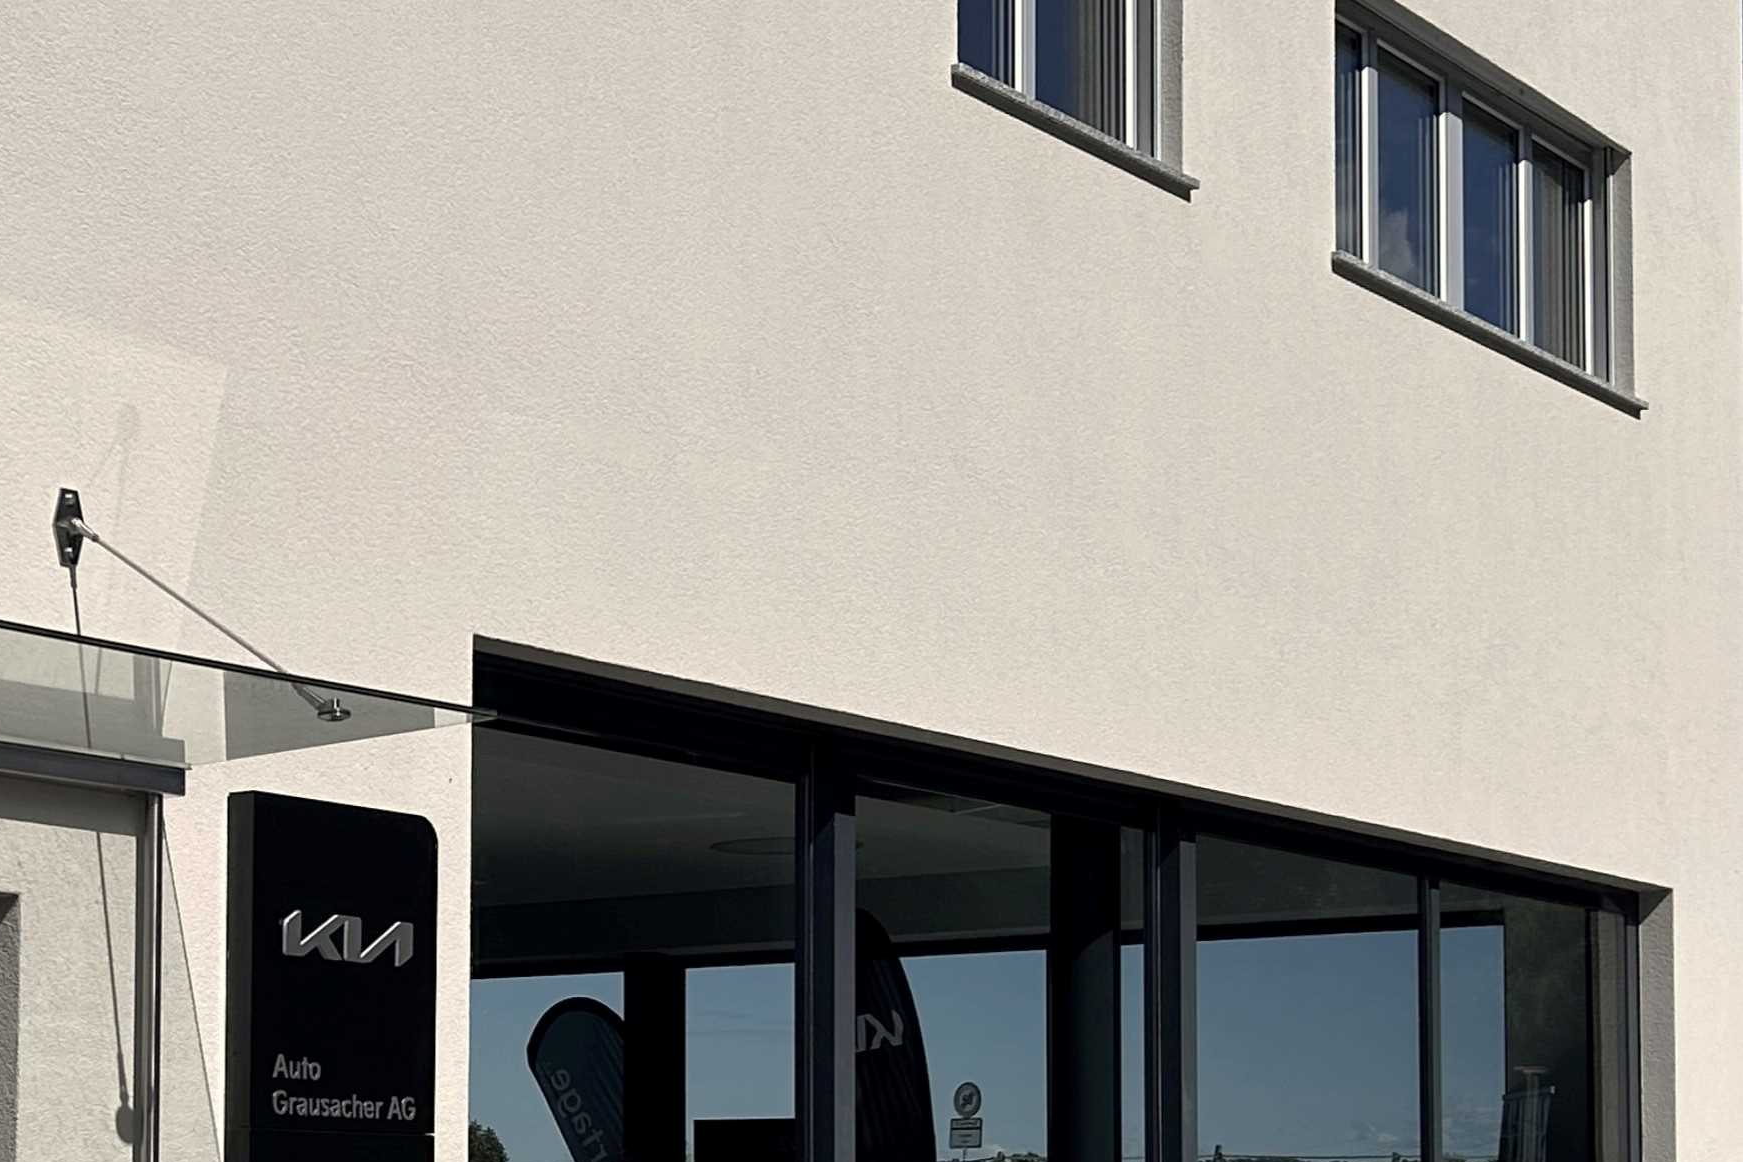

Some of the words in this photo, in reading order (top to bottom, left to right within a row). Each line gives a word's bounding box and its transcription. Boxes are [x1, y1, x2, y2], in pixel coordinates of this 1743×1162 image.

[282, 909, 414, 967] KIA
[272, 1053, 321, 1081] Auto
[272, 1089, 384, 1120] Grausacher
[386, 1096, 417, 1120] AG
